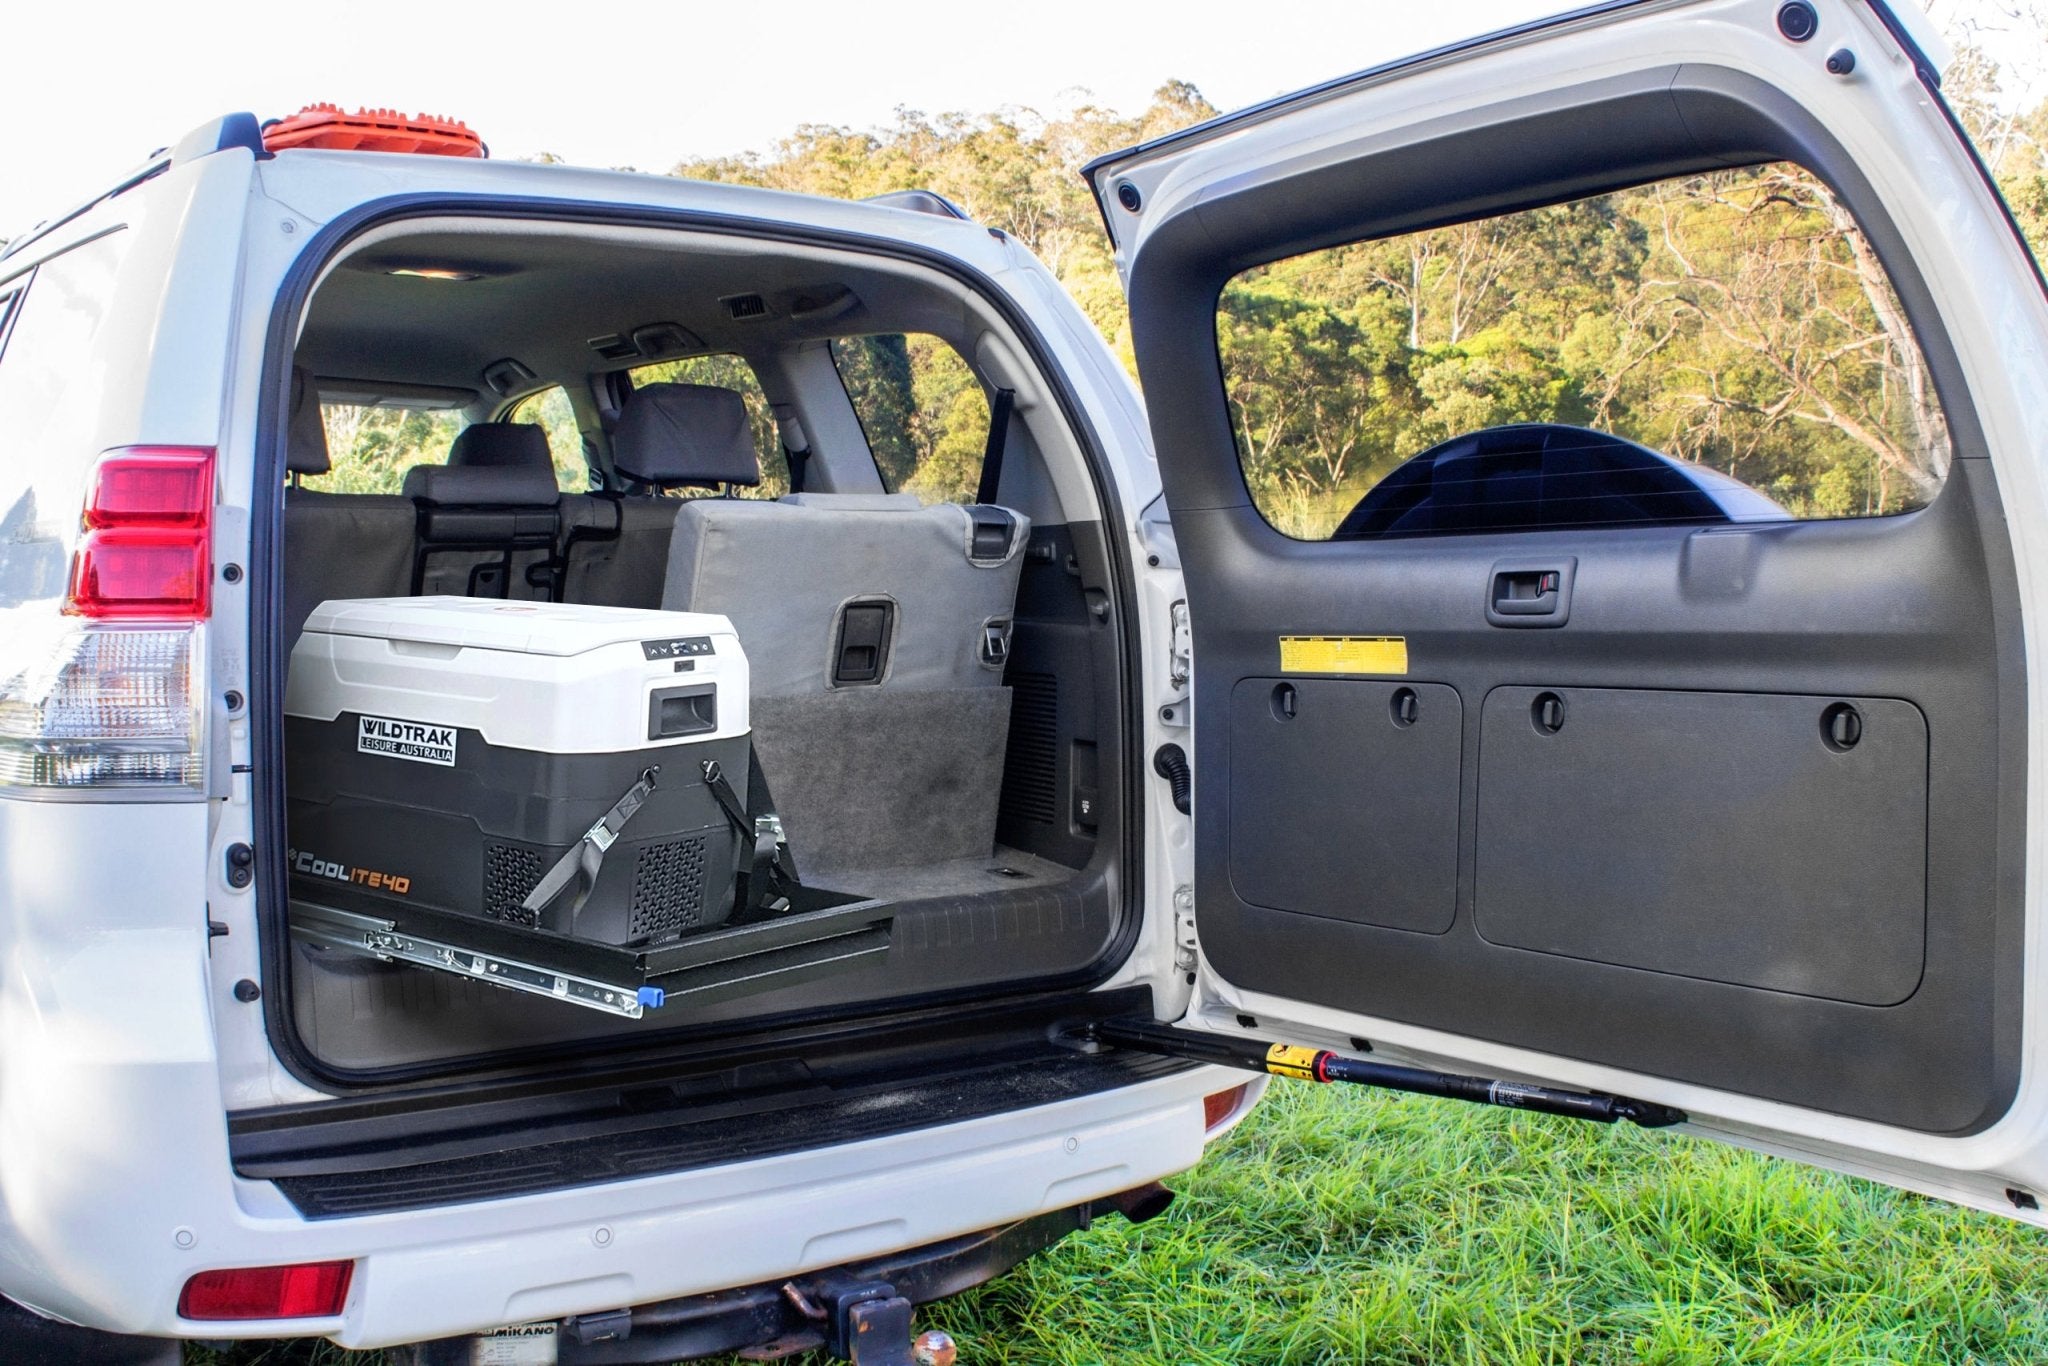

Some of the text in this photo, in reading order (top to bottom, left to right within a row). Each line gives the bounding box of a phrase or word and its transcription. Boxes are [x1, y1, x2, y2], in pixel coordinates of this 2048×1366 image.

[362, 718, 453, 747] WILDTRAK
[361, 738, 452, 761] LEISURE AUSTRALIA
